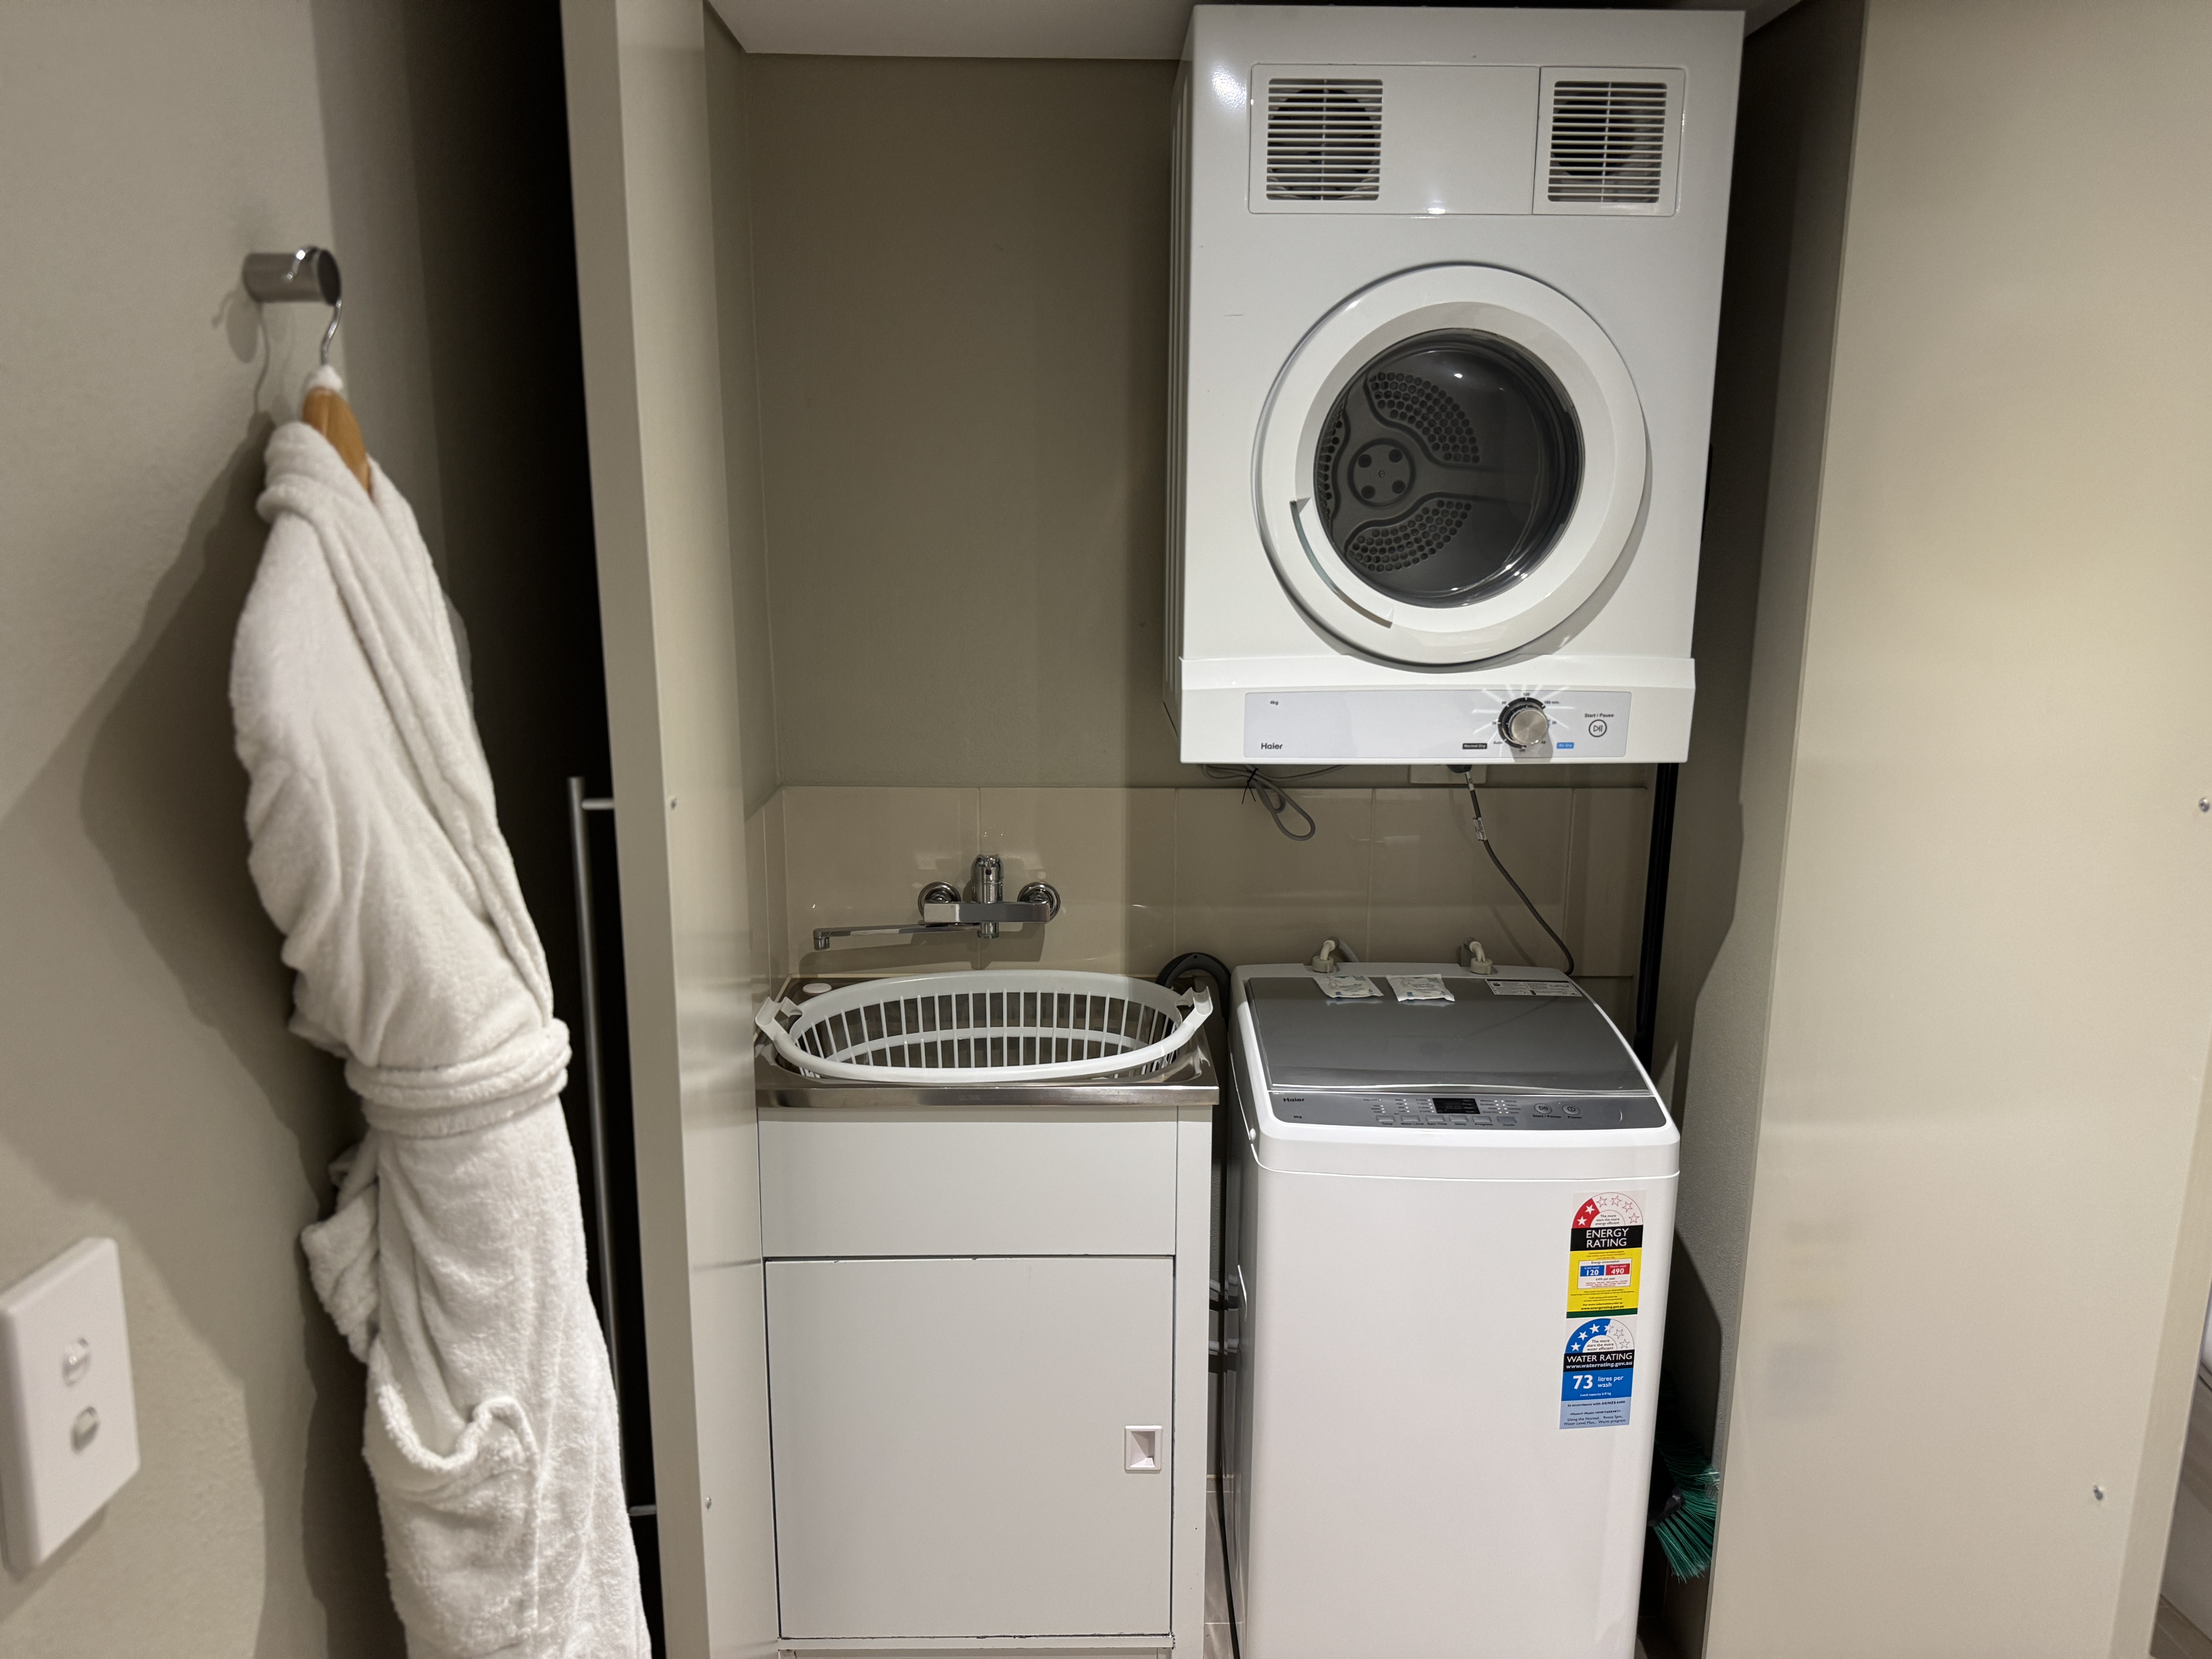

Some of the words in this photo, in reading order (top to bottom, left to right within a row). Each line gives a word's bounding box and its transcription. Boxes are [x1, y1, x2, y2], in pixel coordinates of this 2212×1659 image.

[1586, 1228, 1629, 1238] ENERGY
[1586, 1238, 1627, 1248] RATING
[1600, 1353, 1632, 1361] RATING
[1573, 1375, 1593, 1389] 73
